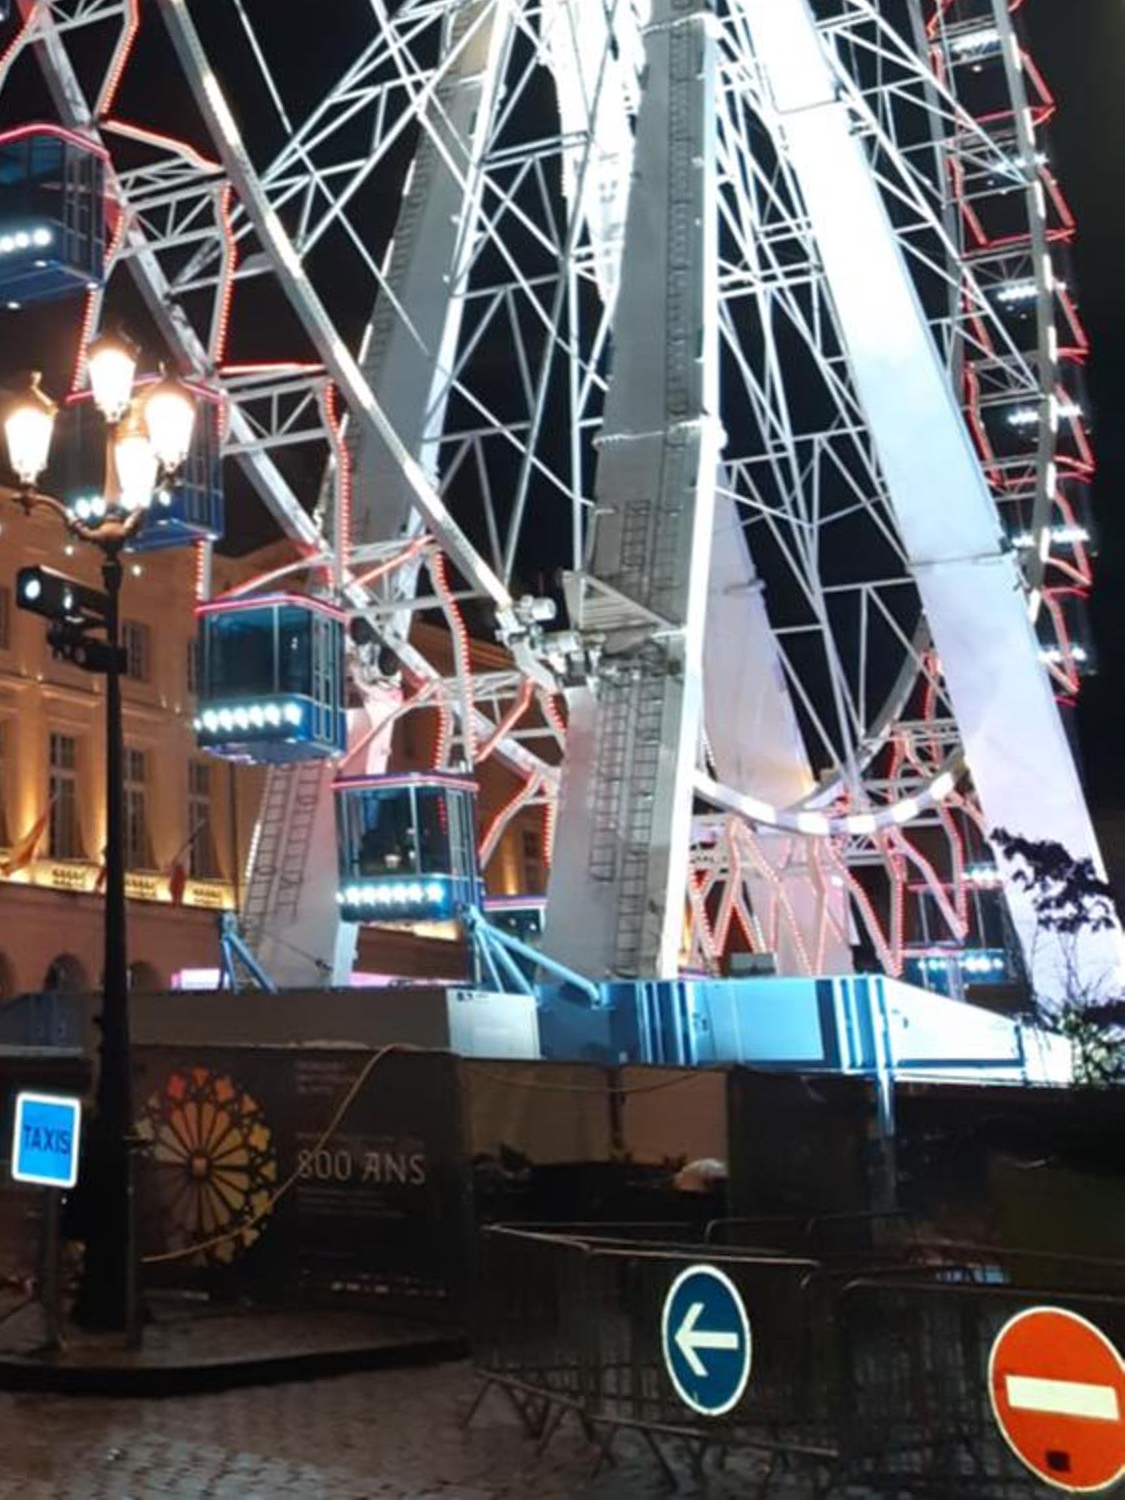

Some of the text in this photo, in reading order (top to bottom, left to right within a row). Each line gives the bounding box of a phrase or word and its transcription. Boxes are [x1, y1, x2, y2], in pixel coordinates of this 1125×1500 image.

[22, 1123, 71, 1156] TAXIS
[297, 1149, 426, 1186] 800 ANS
